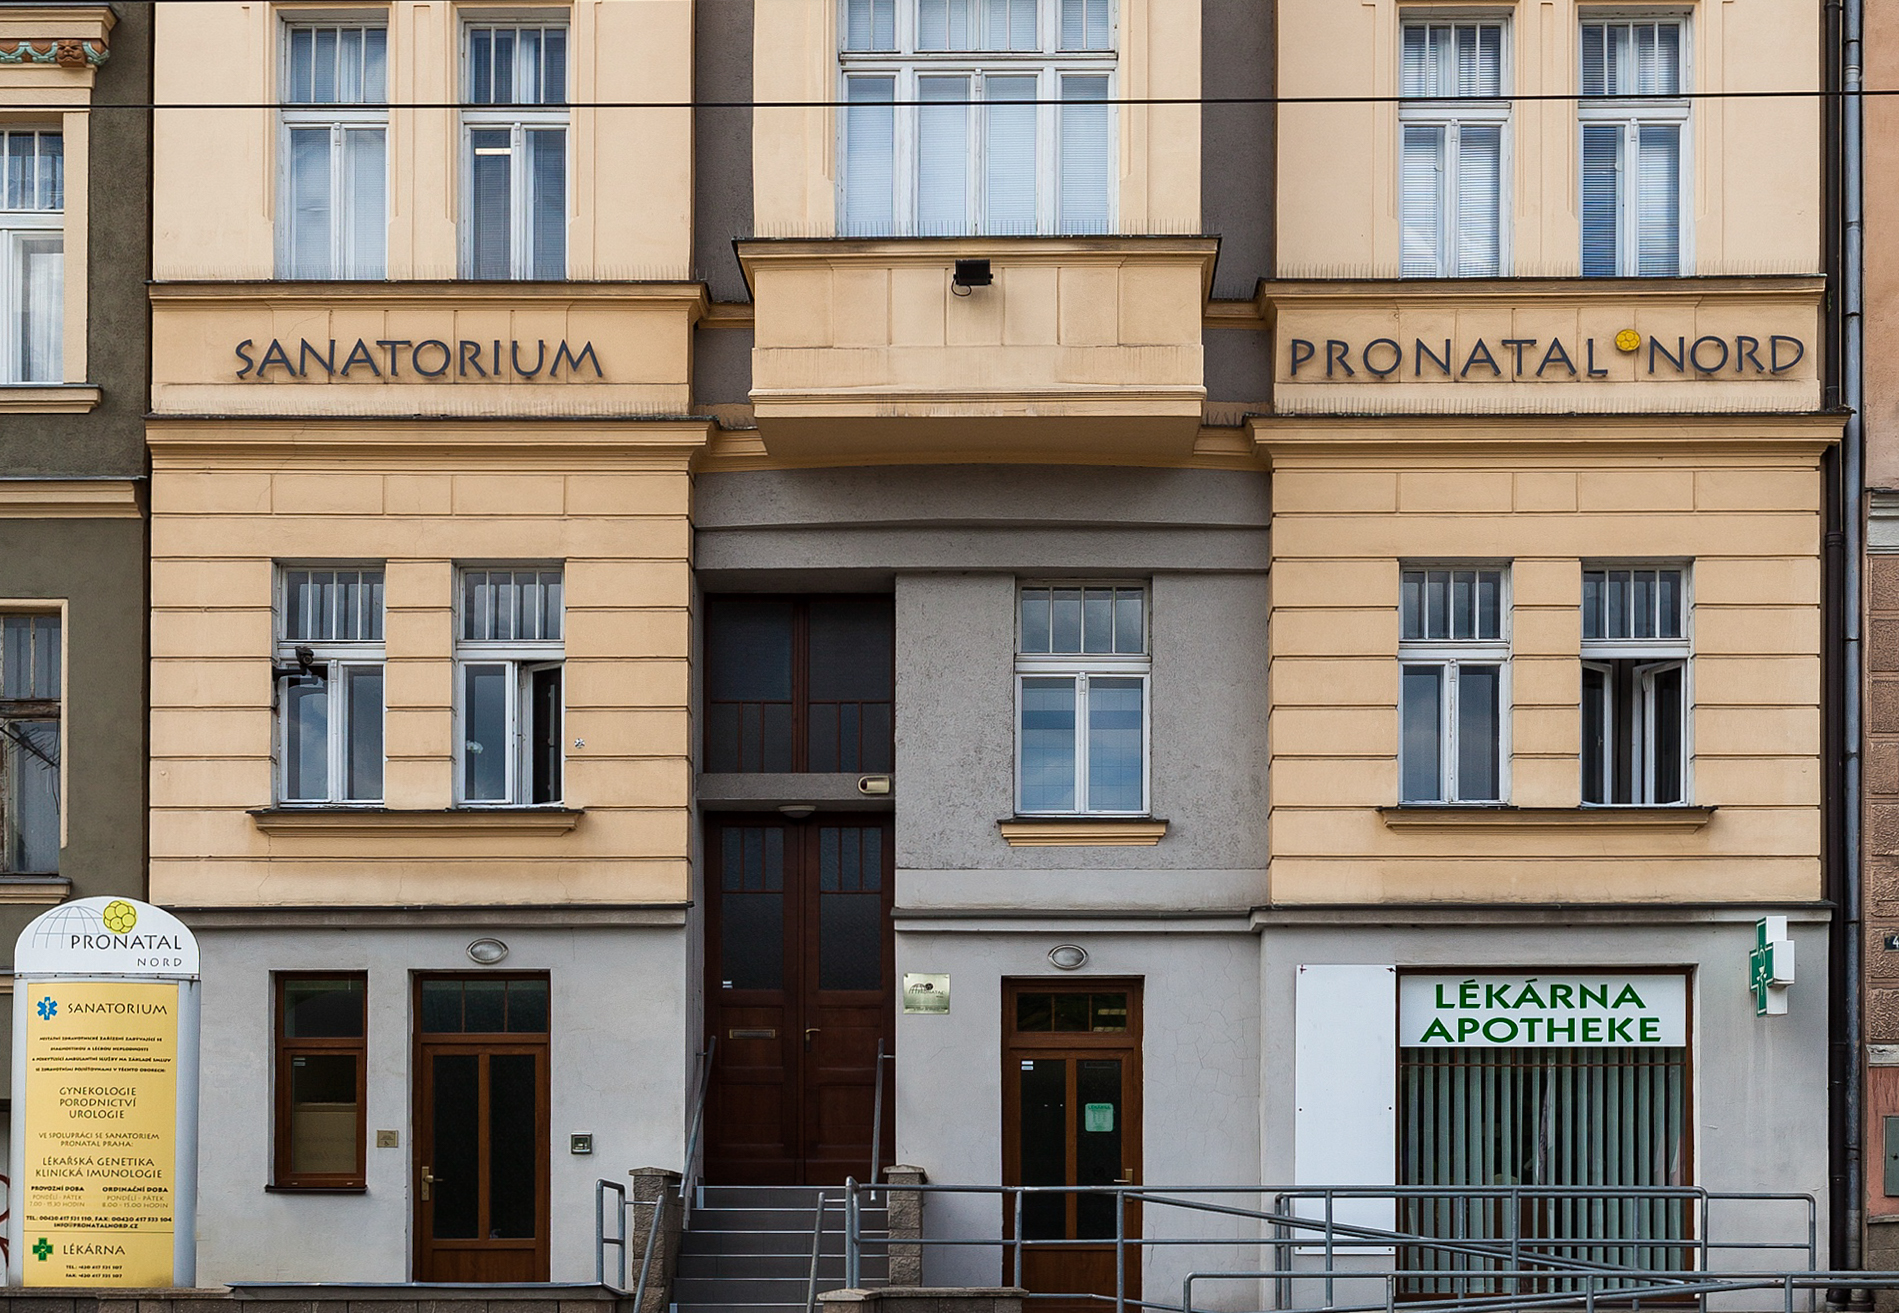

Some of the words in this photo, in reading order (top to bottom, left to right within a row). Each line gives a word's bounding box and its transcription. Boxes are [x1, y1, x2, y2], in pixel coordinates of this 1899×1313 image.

[235, 338, 603, 378] SANATORIUM
[1290, 337, 1608, 377] PRONATAL
[1649, 335, 1804, 374] NORD
[71, 934, 182, 950] PRONATAL
[137, 958, 182, 967] NORD
[1436, 978, 1647, 1009] LÉKÁRNA
[67, 1002, 167, 1015] SANATORIUM
[1419, 1017, 1662, 1043] APOTHEKE
[59, 1087, 136, 1096] GYNEKOLOGIE
[59, 1097, 136, 1107] PORODNICTVÍ
[69, 1110, 125, 1119] UROLOGIE
[49, 1131, 93, 1139] SPOLUPRÁCI
[42, 1155, 94, 1166] LÉKAŘSKÁ
[97, 1157, 155, 1167] GENETIKA
[35, 1167, 83, 1178] KLINICKÁ
[87, 1169, 162, 1178] IMUNOLOGIE
[63, 1242, 125, 1255] LÉKÁRNA
